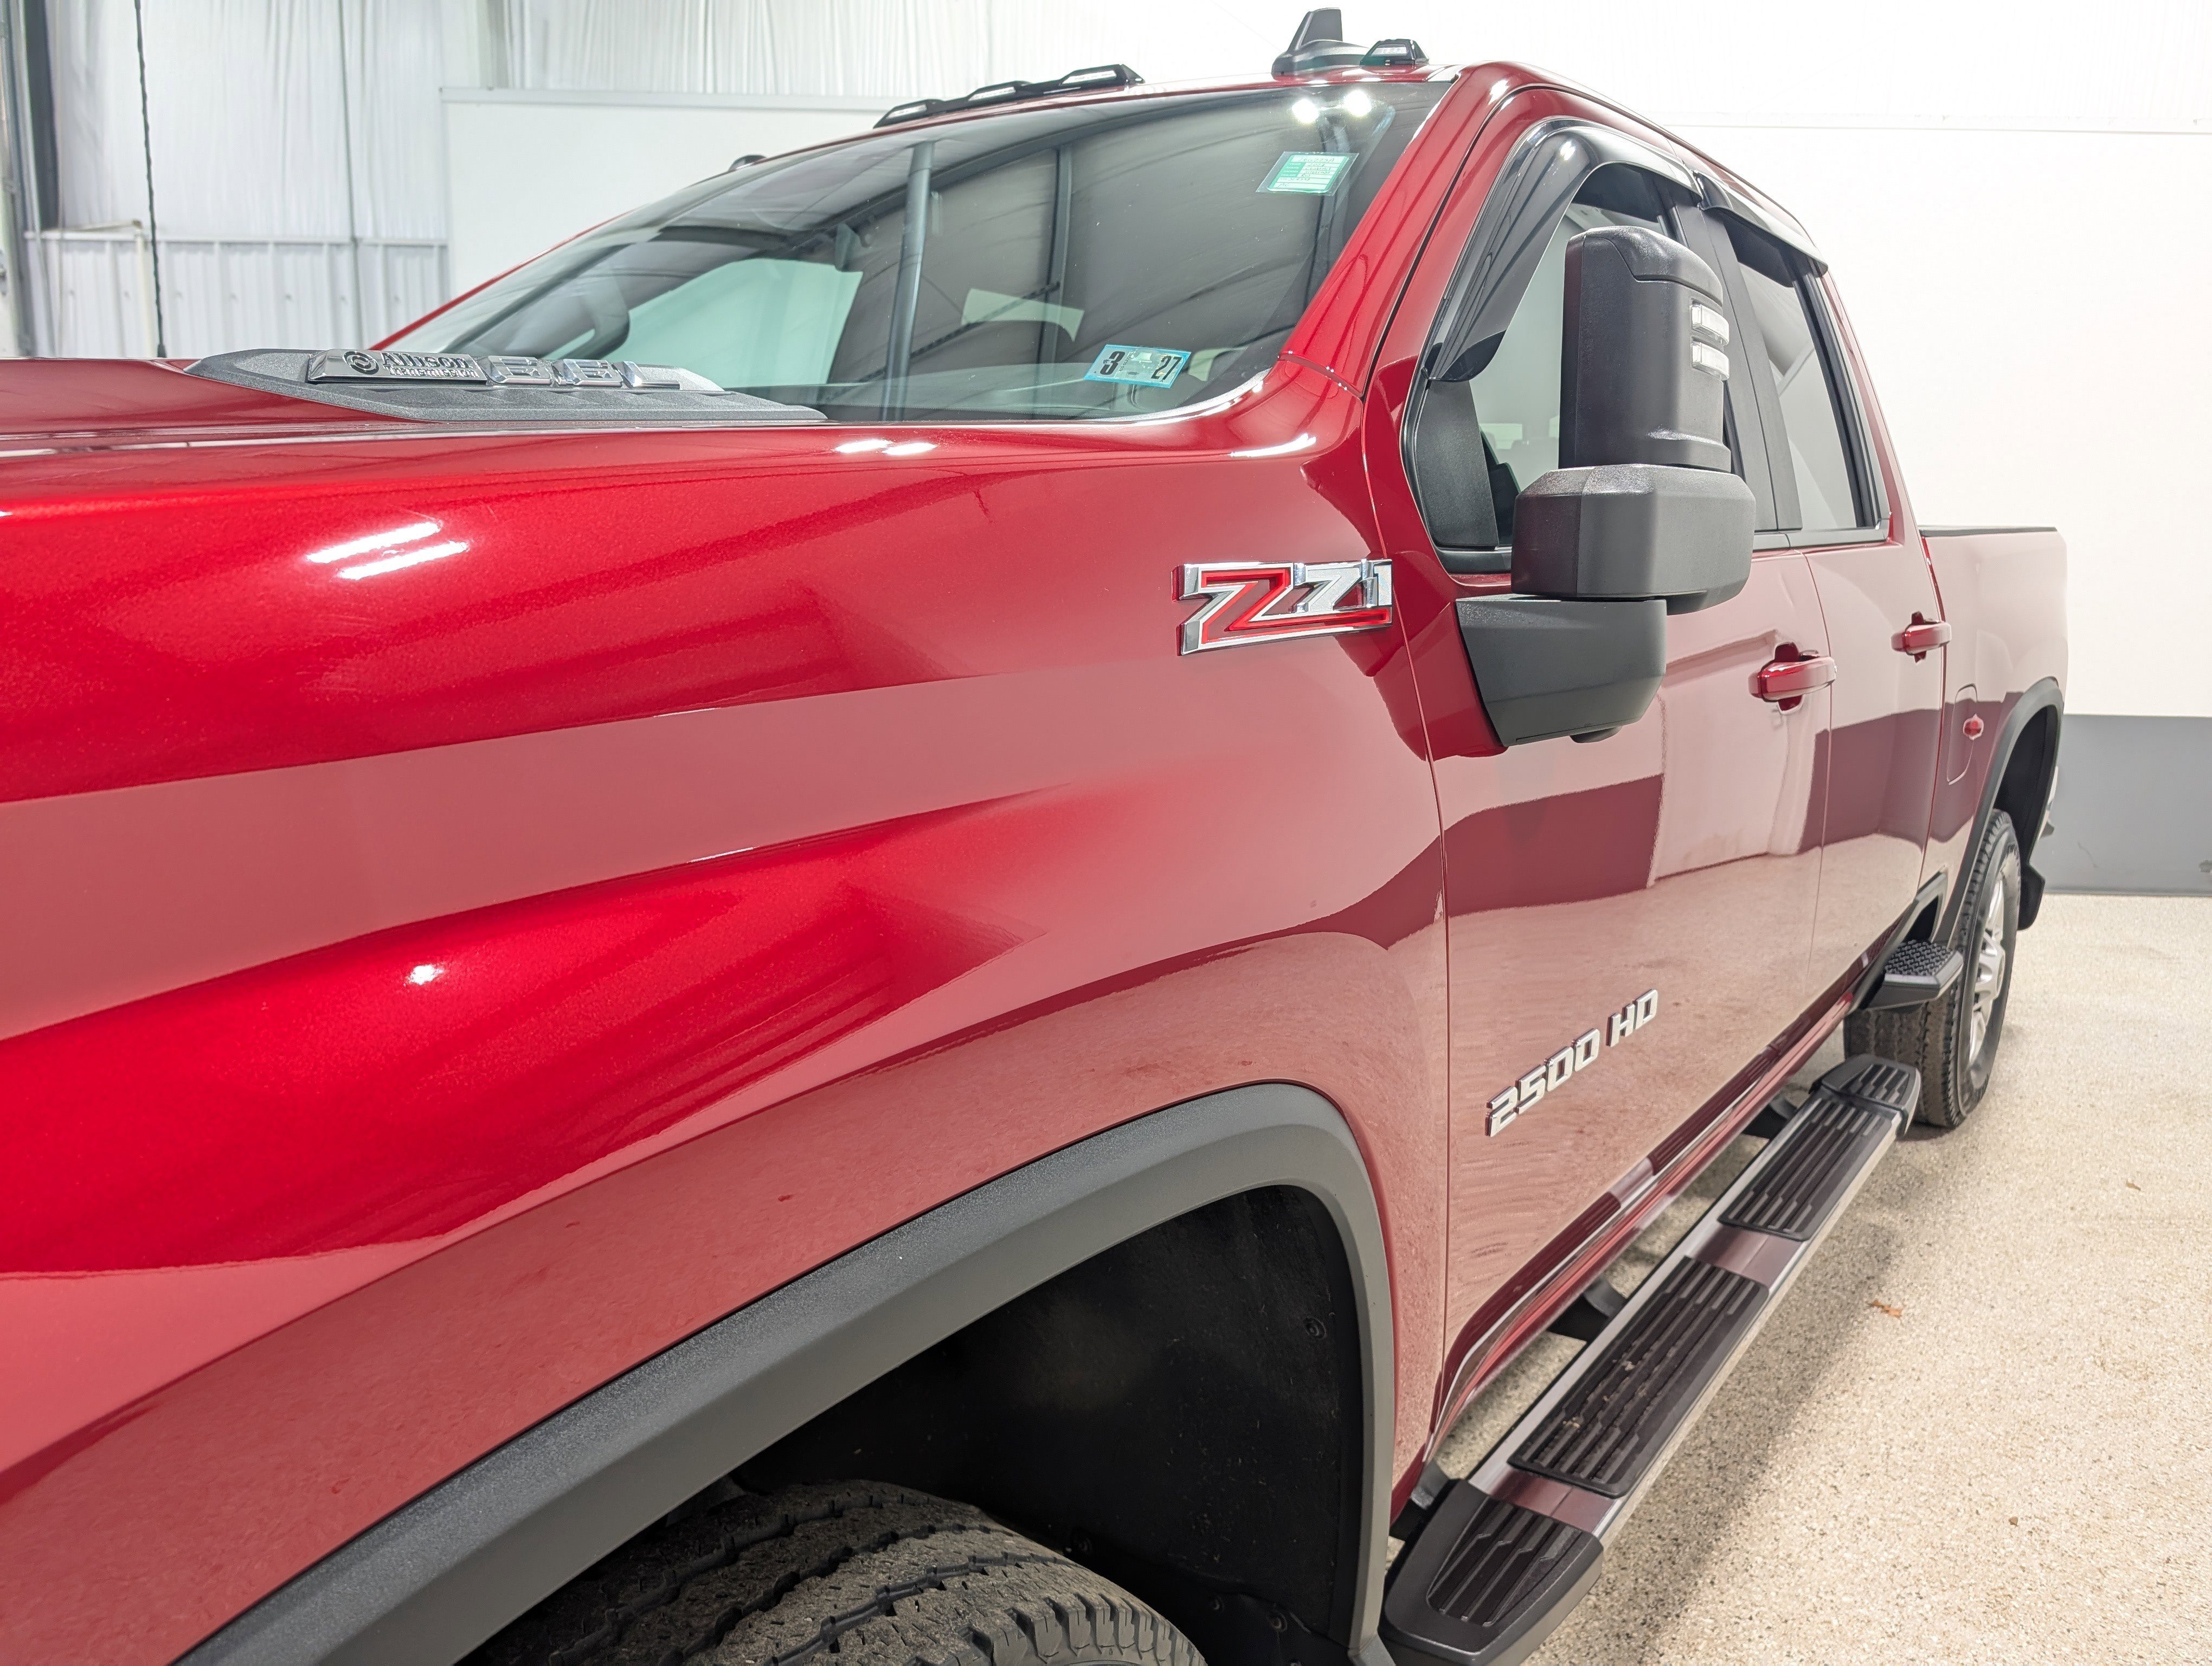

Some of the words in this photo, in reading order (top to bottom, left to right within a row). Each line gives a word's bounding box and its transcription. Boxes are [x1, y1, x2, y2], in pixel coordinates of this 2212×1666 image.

[381, 352, 473, 369] Allison
[385, 365, 480, 378] Transmission
[1100, 351, 1125, 375] 3
[1150, 356, 1182, 380] 27
[1172, 559, 1393, 656] Z71
[1484, 1028, 1600, 1137] 2500
[1606, 989, 1659, 1047] HD
